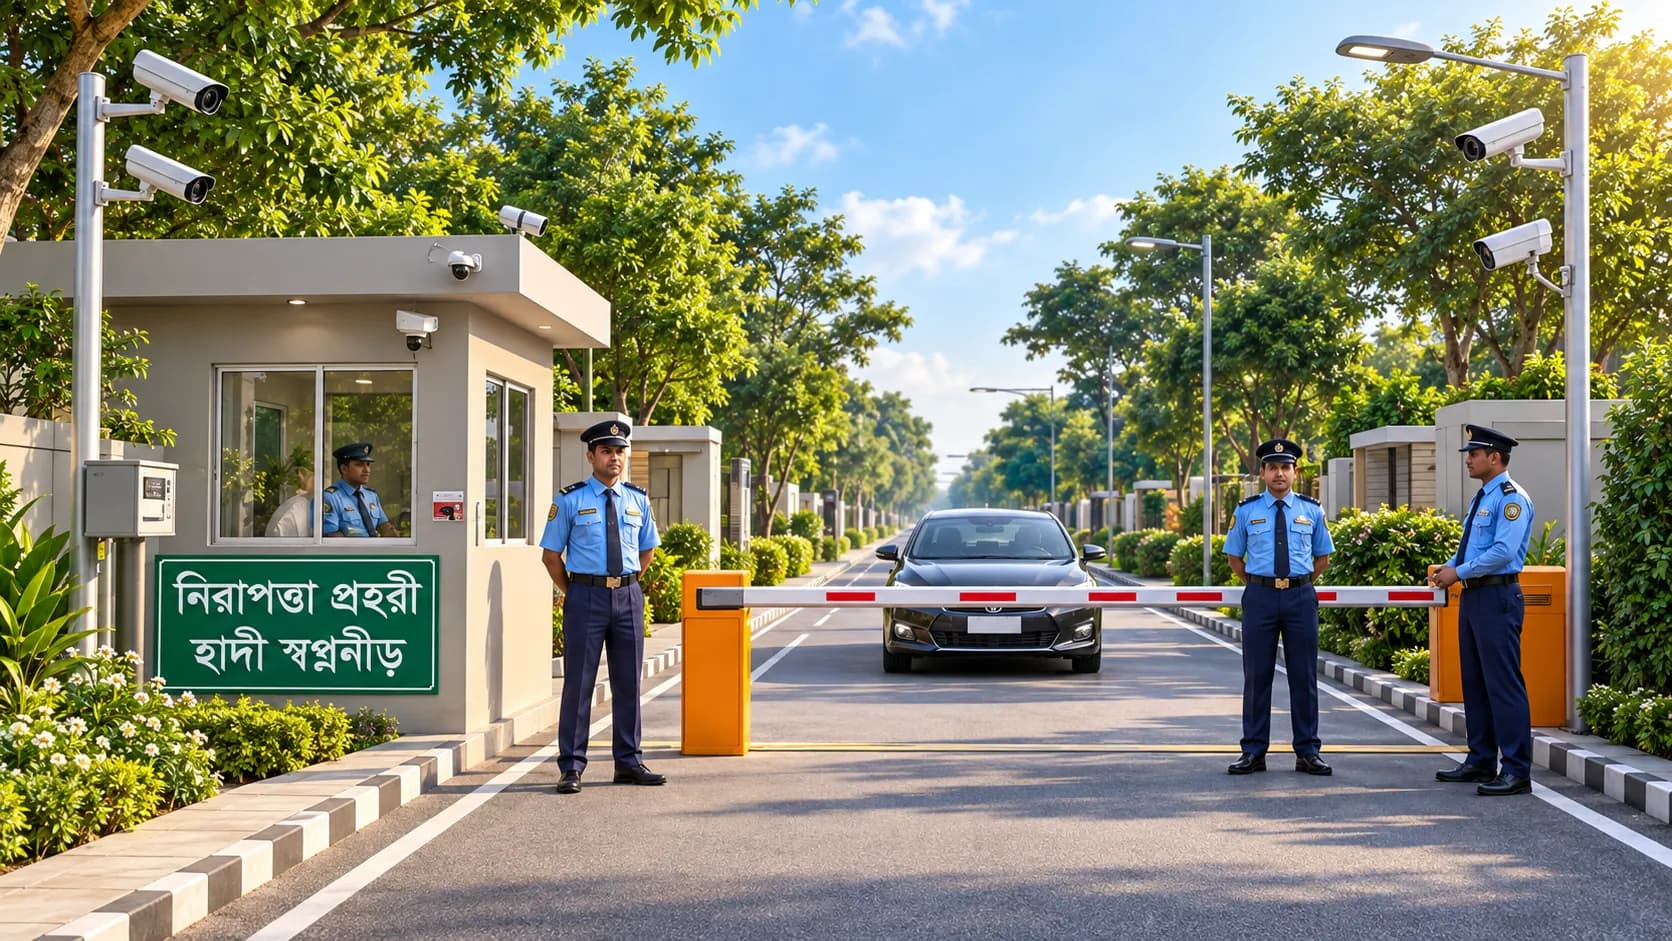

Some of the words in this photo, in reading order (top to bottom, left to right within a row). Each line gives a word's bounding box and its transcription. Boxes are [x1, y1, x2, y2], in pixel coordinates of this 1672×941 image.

[172, 570, 319, 615] নিরাপত্তা
[331, 569, 423, 619] প্রহরী
[189, 625, 269, 676] হাদী
[278, 625, 408, 678] স্বপ্ননীড়
